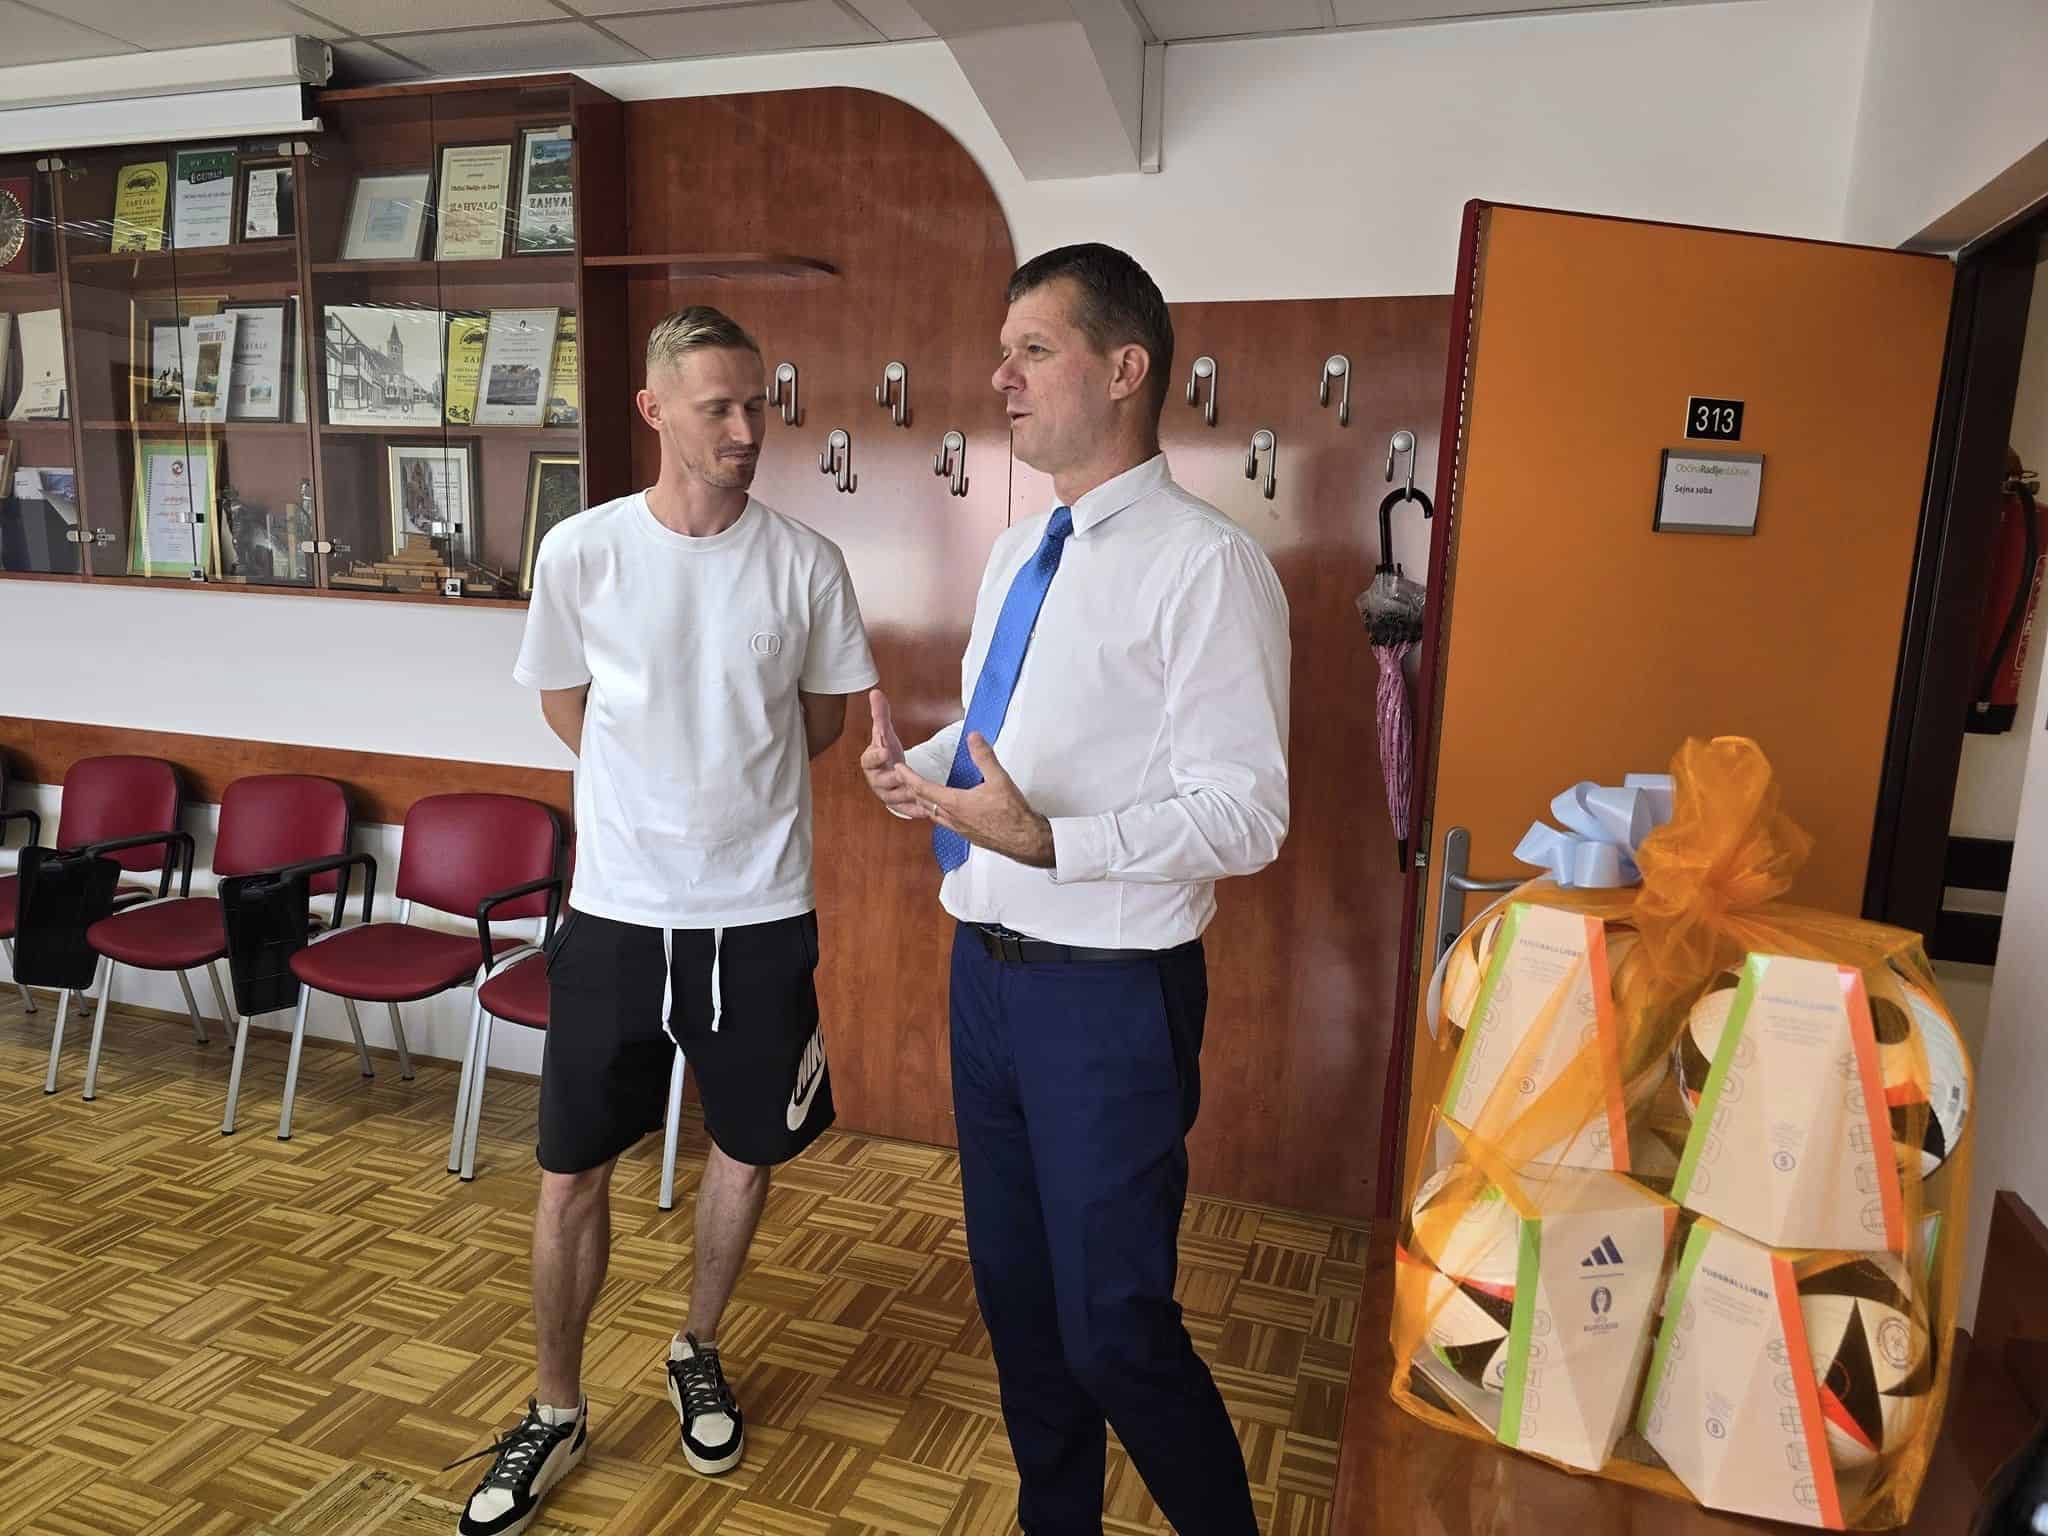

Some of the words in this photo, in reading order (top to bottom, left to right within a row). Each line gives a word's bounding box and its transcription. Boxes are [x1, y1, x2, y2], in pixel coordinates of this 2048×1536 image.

[1695, 405, 1735, 433] 313
[1674, 484, 1694, 495] Sejna
[1695, 485, 1713, 495] soba
